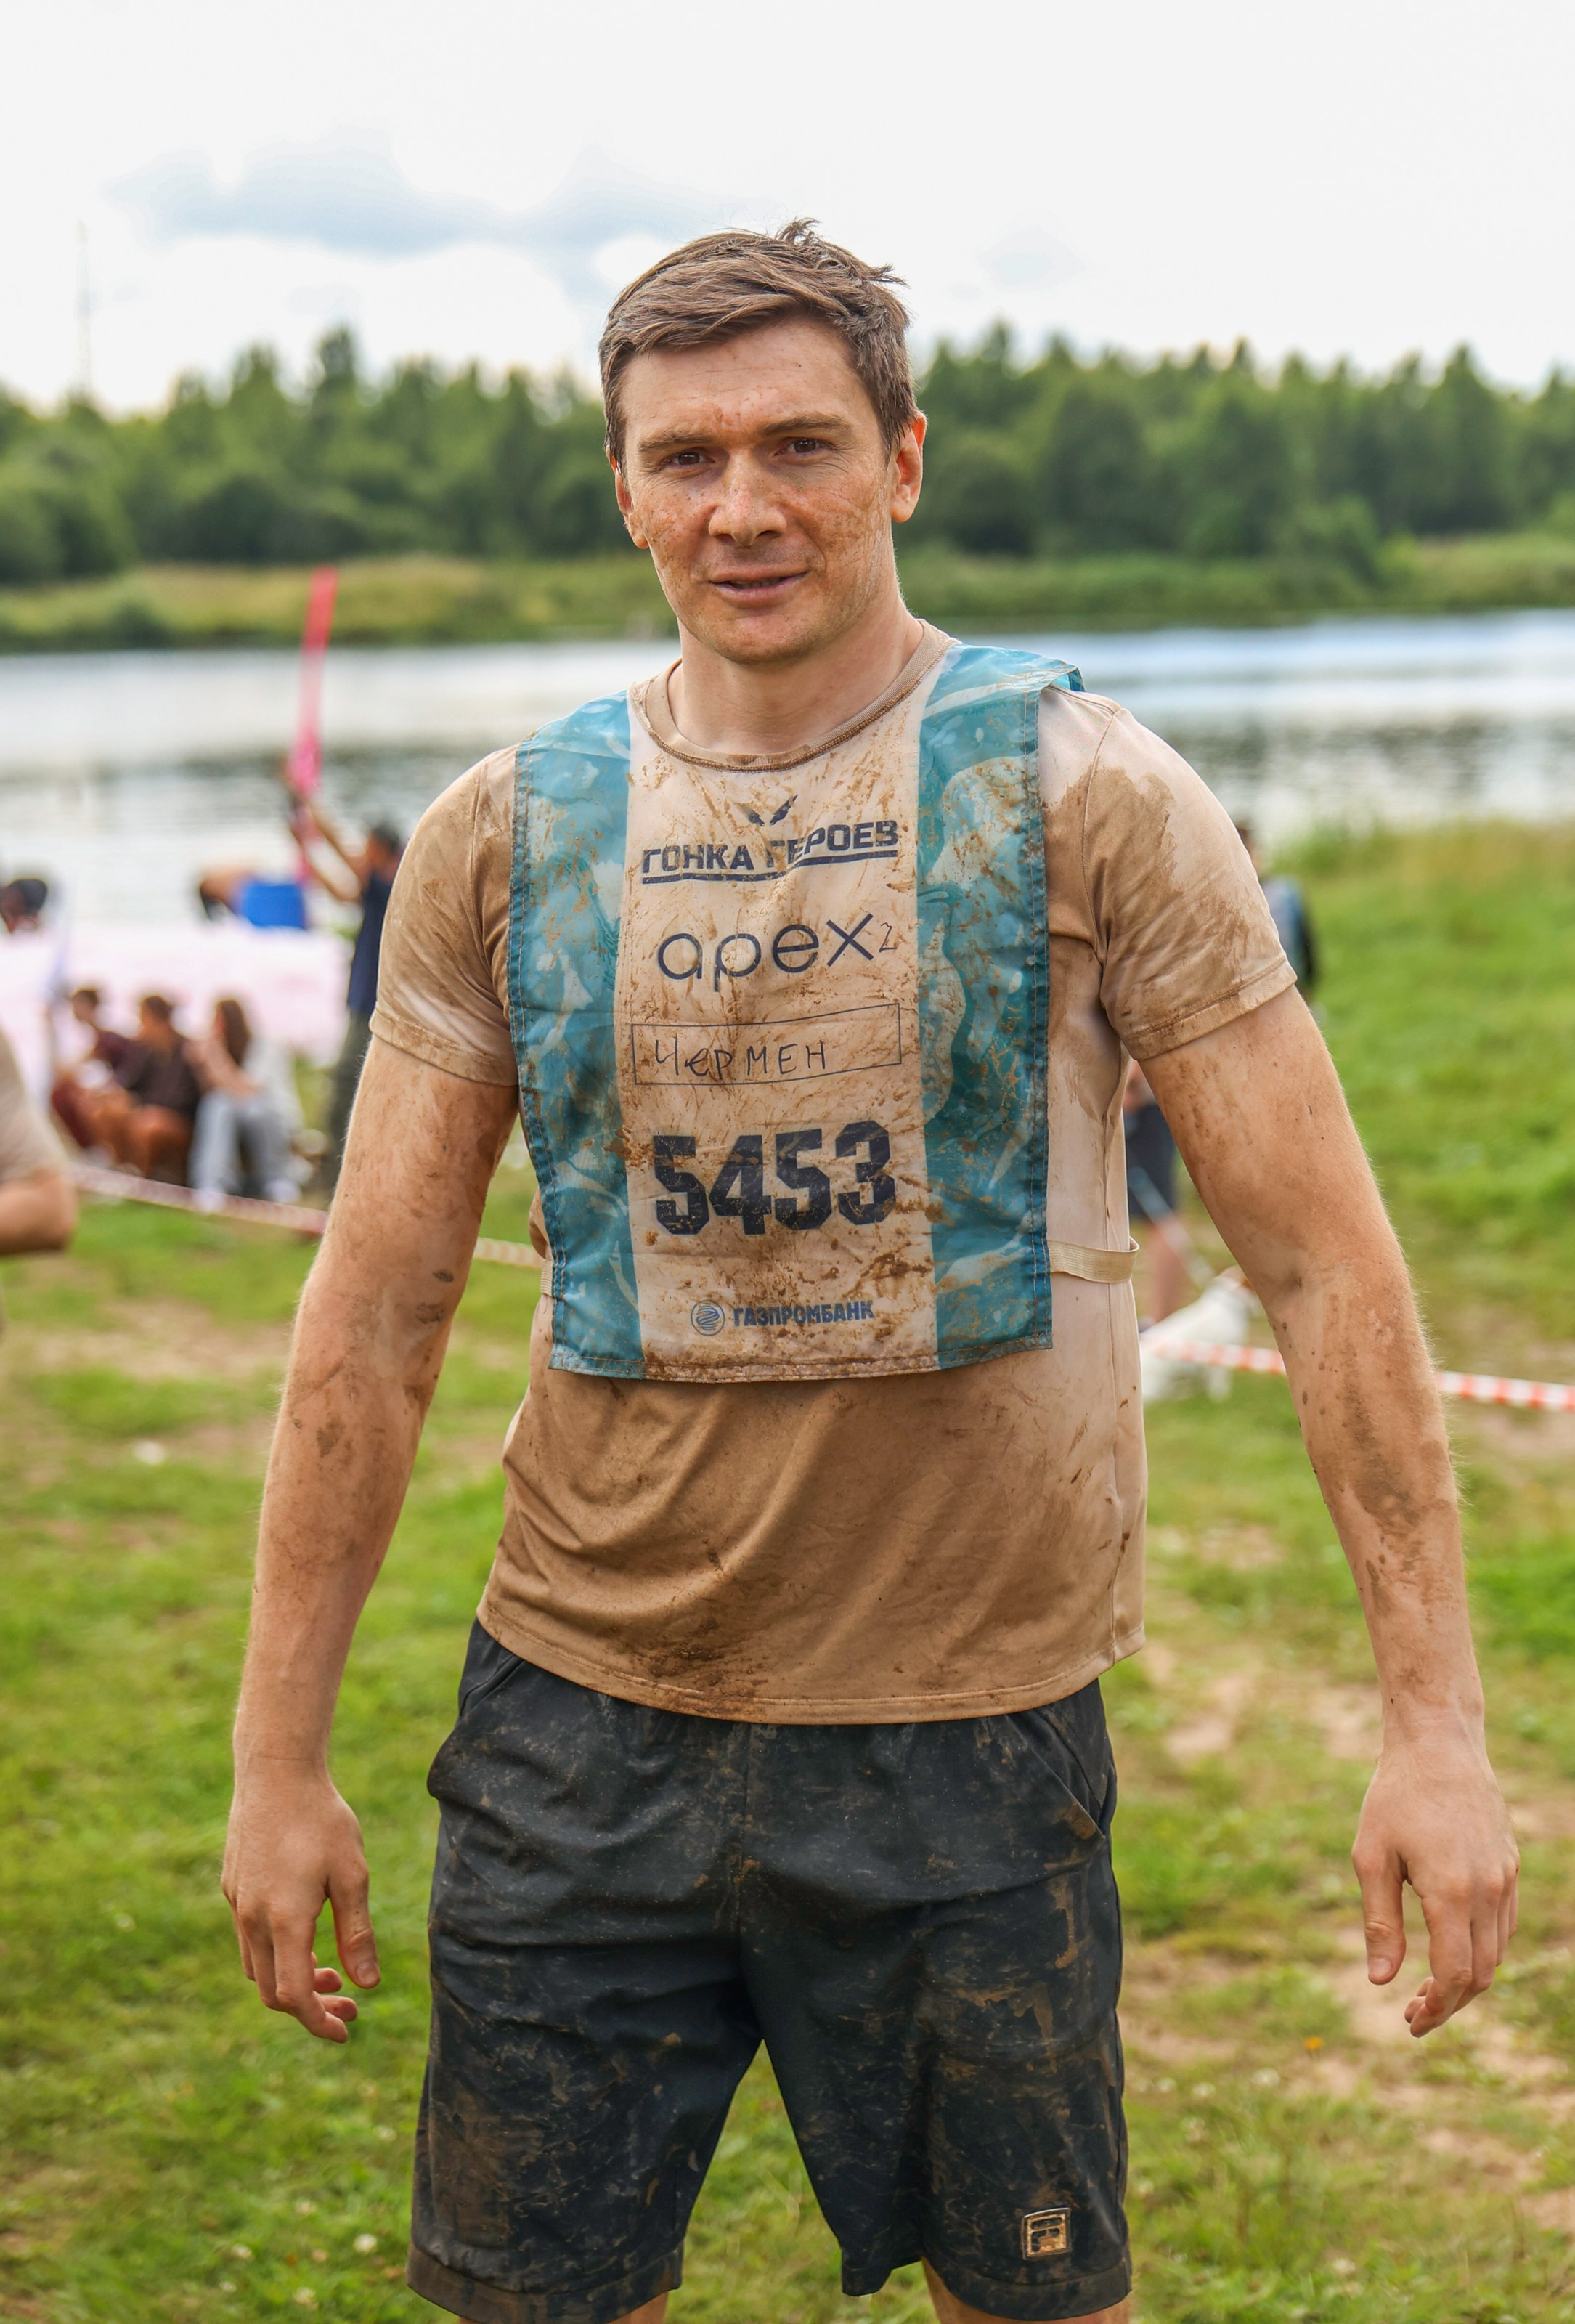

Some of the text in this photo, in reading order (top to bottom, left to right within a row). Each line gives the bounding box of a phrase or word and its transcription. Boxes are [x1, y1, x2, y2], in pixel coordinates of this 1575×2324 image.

[642, 820, 898, 874] ГОНКА ГЕРОЕВ
[657, 913, 874, 992] apex
[654, 1120, 895, 1235] 5453
[733, 1301, 874, 1327] ГАЗПРОМБАНК
